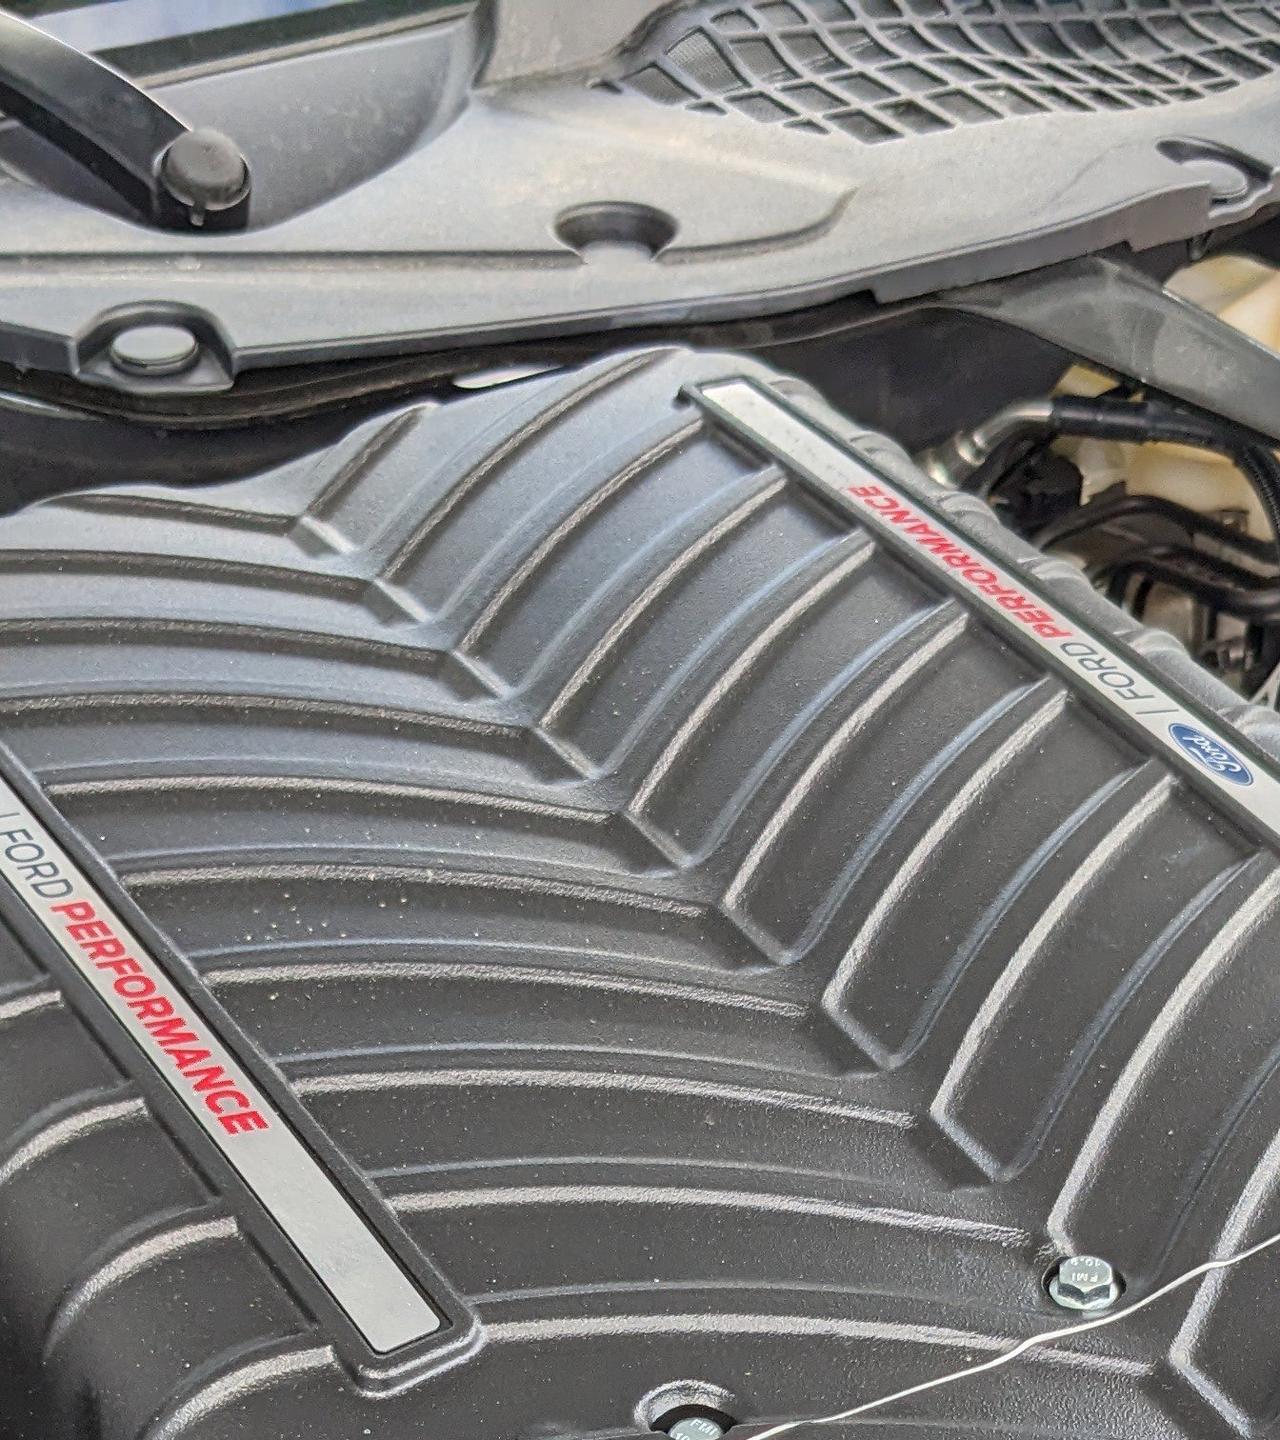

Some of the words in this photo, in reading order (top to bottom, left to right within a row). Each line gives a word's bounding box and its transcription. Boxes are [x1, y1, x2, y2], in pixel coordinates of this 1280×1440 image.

[846, 484, 1073, 638] PERFORMANCE
[1060, 642, 1155, 700] FORD
[1176, 729, 1246, 778] Ford
[50, 901, 269, 1136] PERFORMANCE
